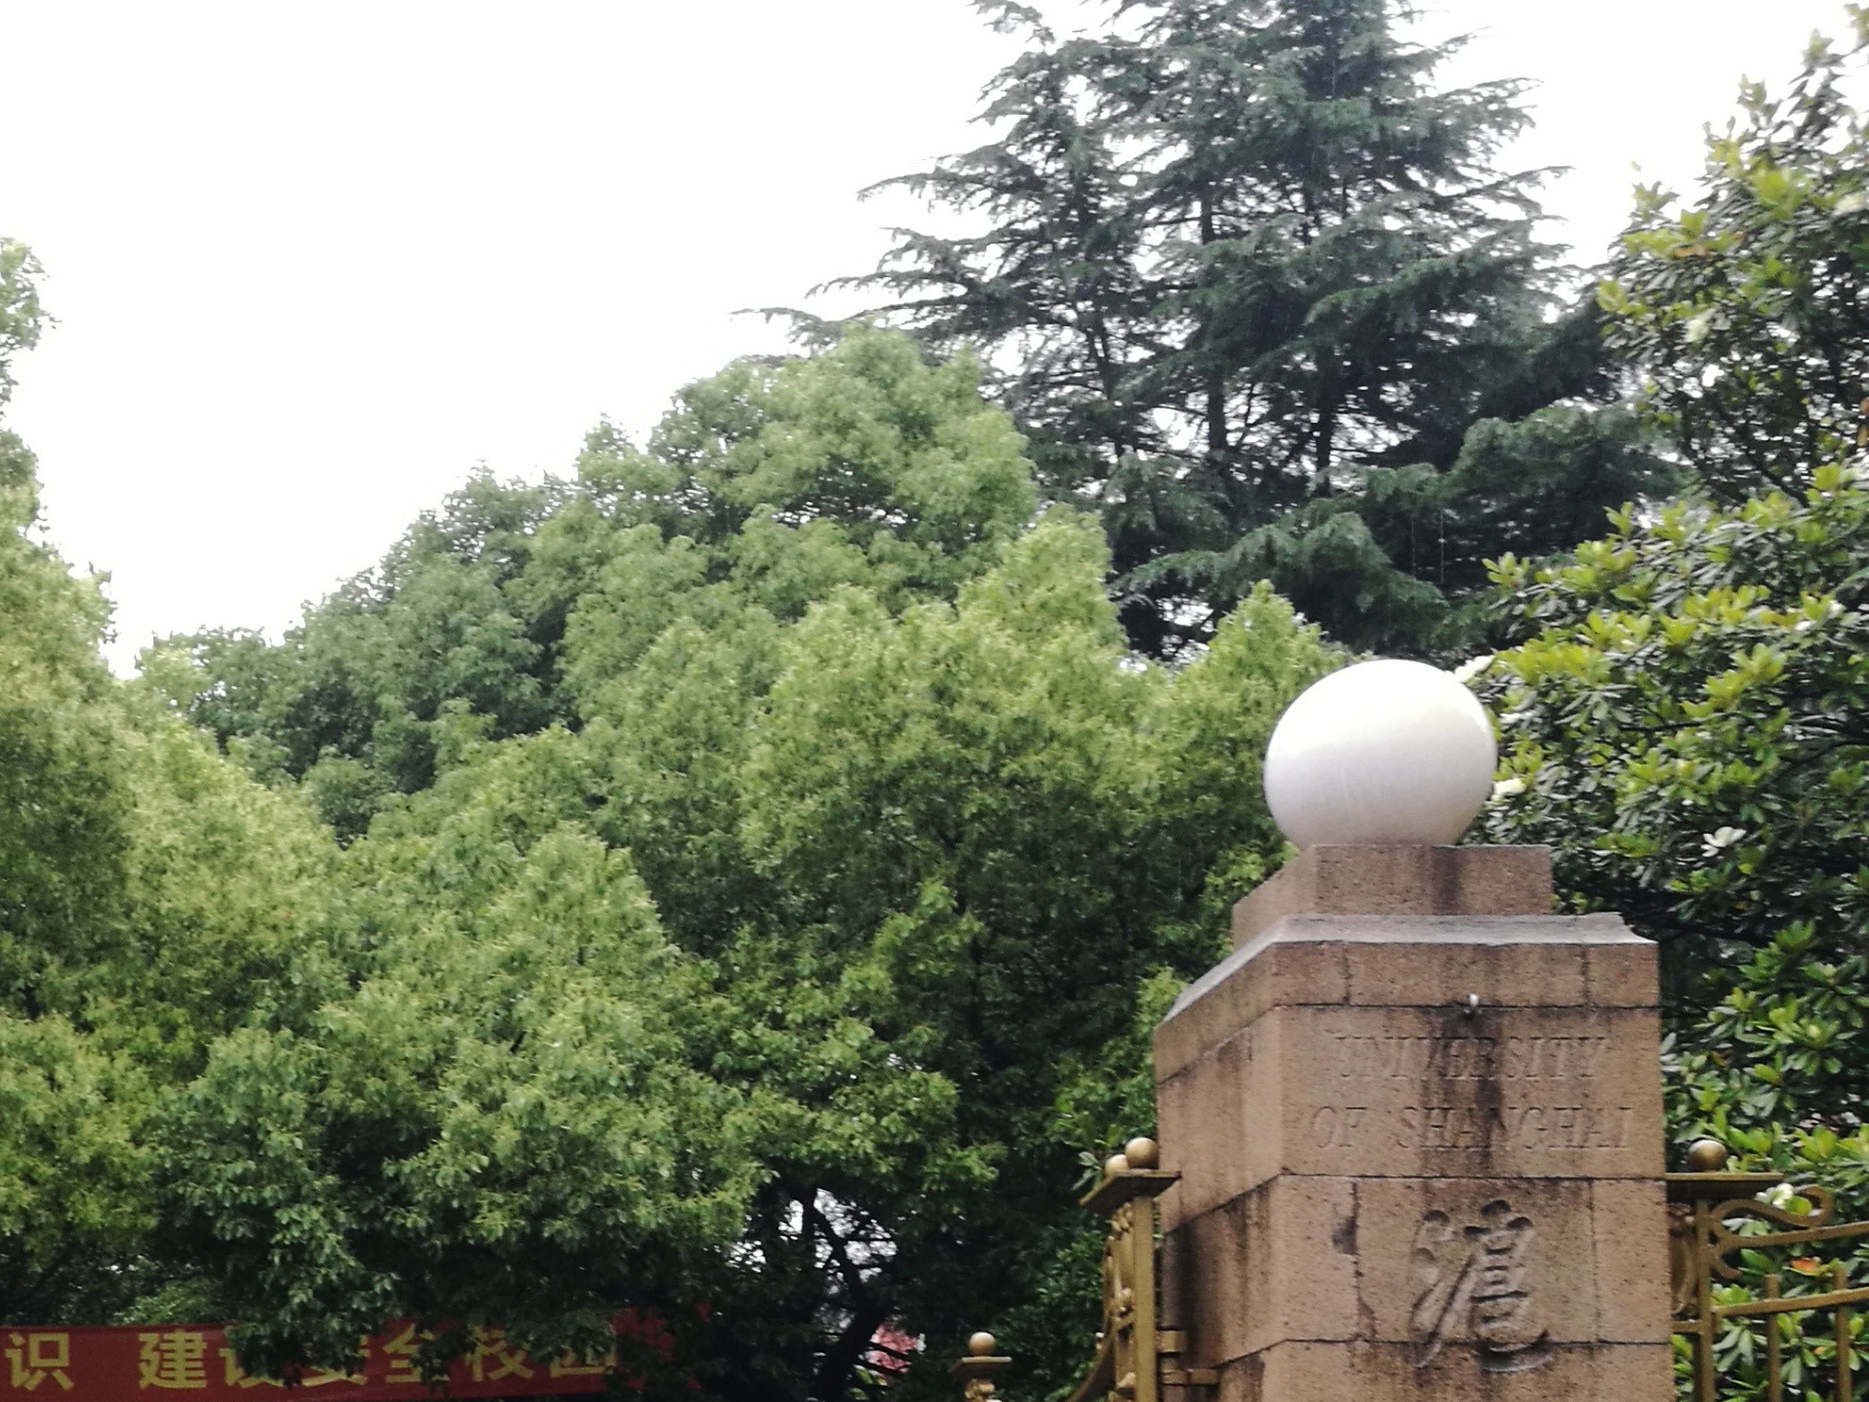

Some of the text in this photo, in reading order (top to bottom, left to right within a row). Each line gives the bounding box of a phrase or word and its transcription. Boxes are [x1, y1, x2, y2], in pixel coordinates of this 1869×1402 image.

[1332, 1034, 1610, 1081] UNIVERSITY
[1310, 1104, 1633, 1150] OF SHANGHAI
